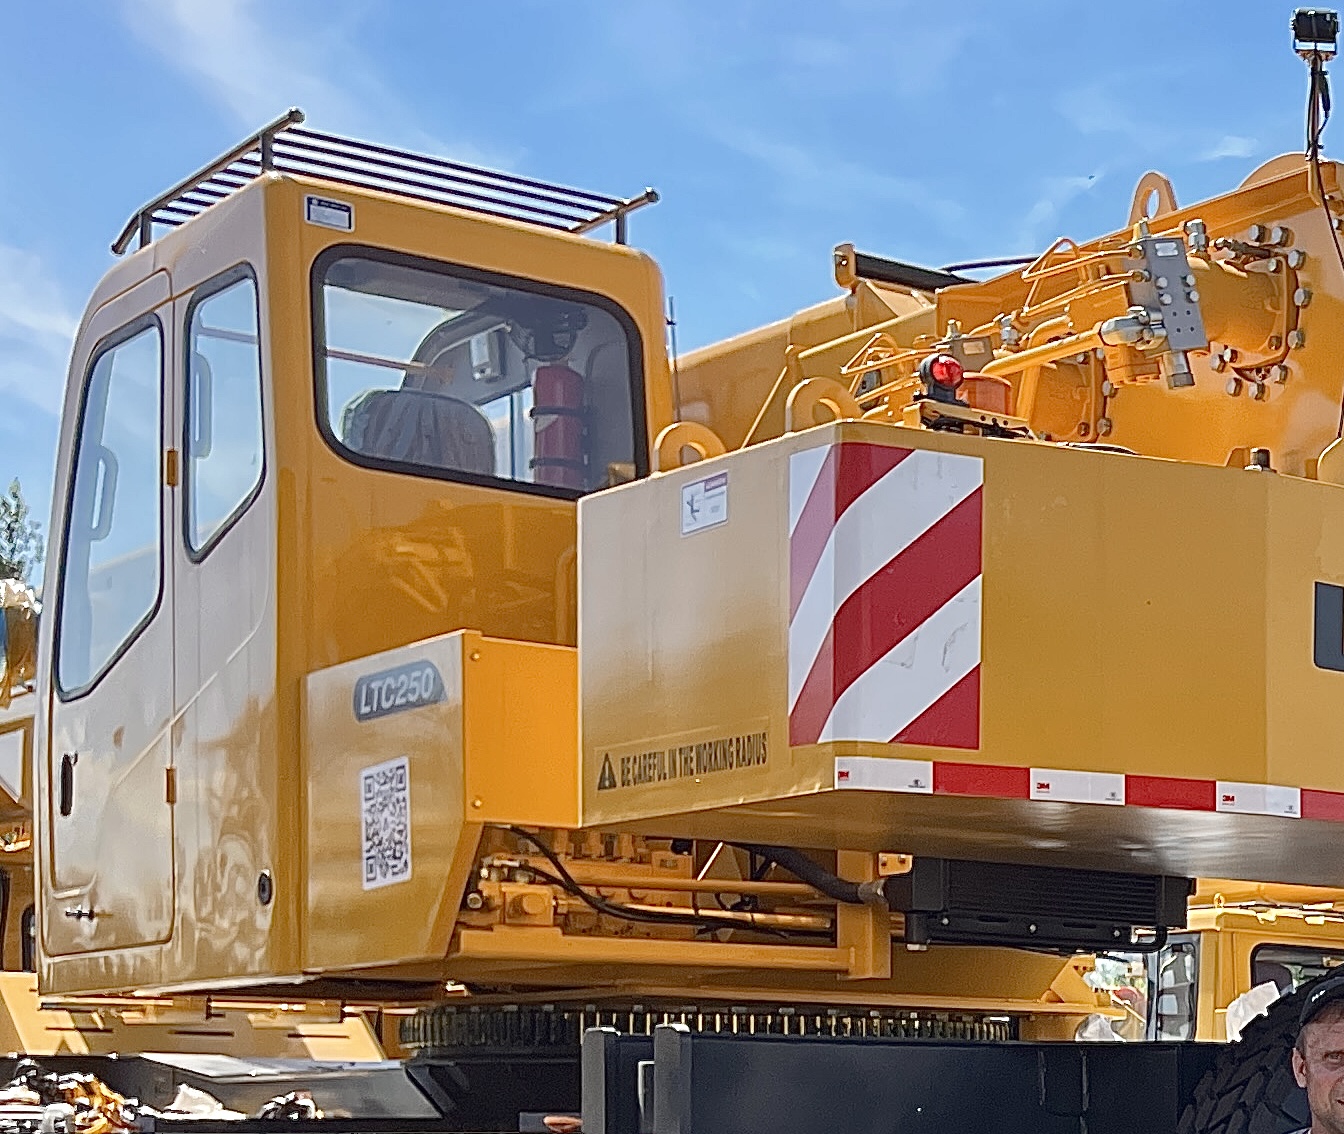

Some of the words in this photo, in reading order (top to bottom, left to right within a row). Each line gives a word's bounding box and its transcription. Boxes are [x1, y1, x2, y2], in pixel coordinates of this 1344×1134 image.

[358, 664, 435, 718] LTC250
[621, 756, 631, 787] BE
[632, 751, 667, 786] CAREFUL
[667, 748, 678, 779] IN
[678, 745, 694, 777] THE
[695, 737, 734, 775] WORKING
[735, 731, 768, 768] RADIUS
